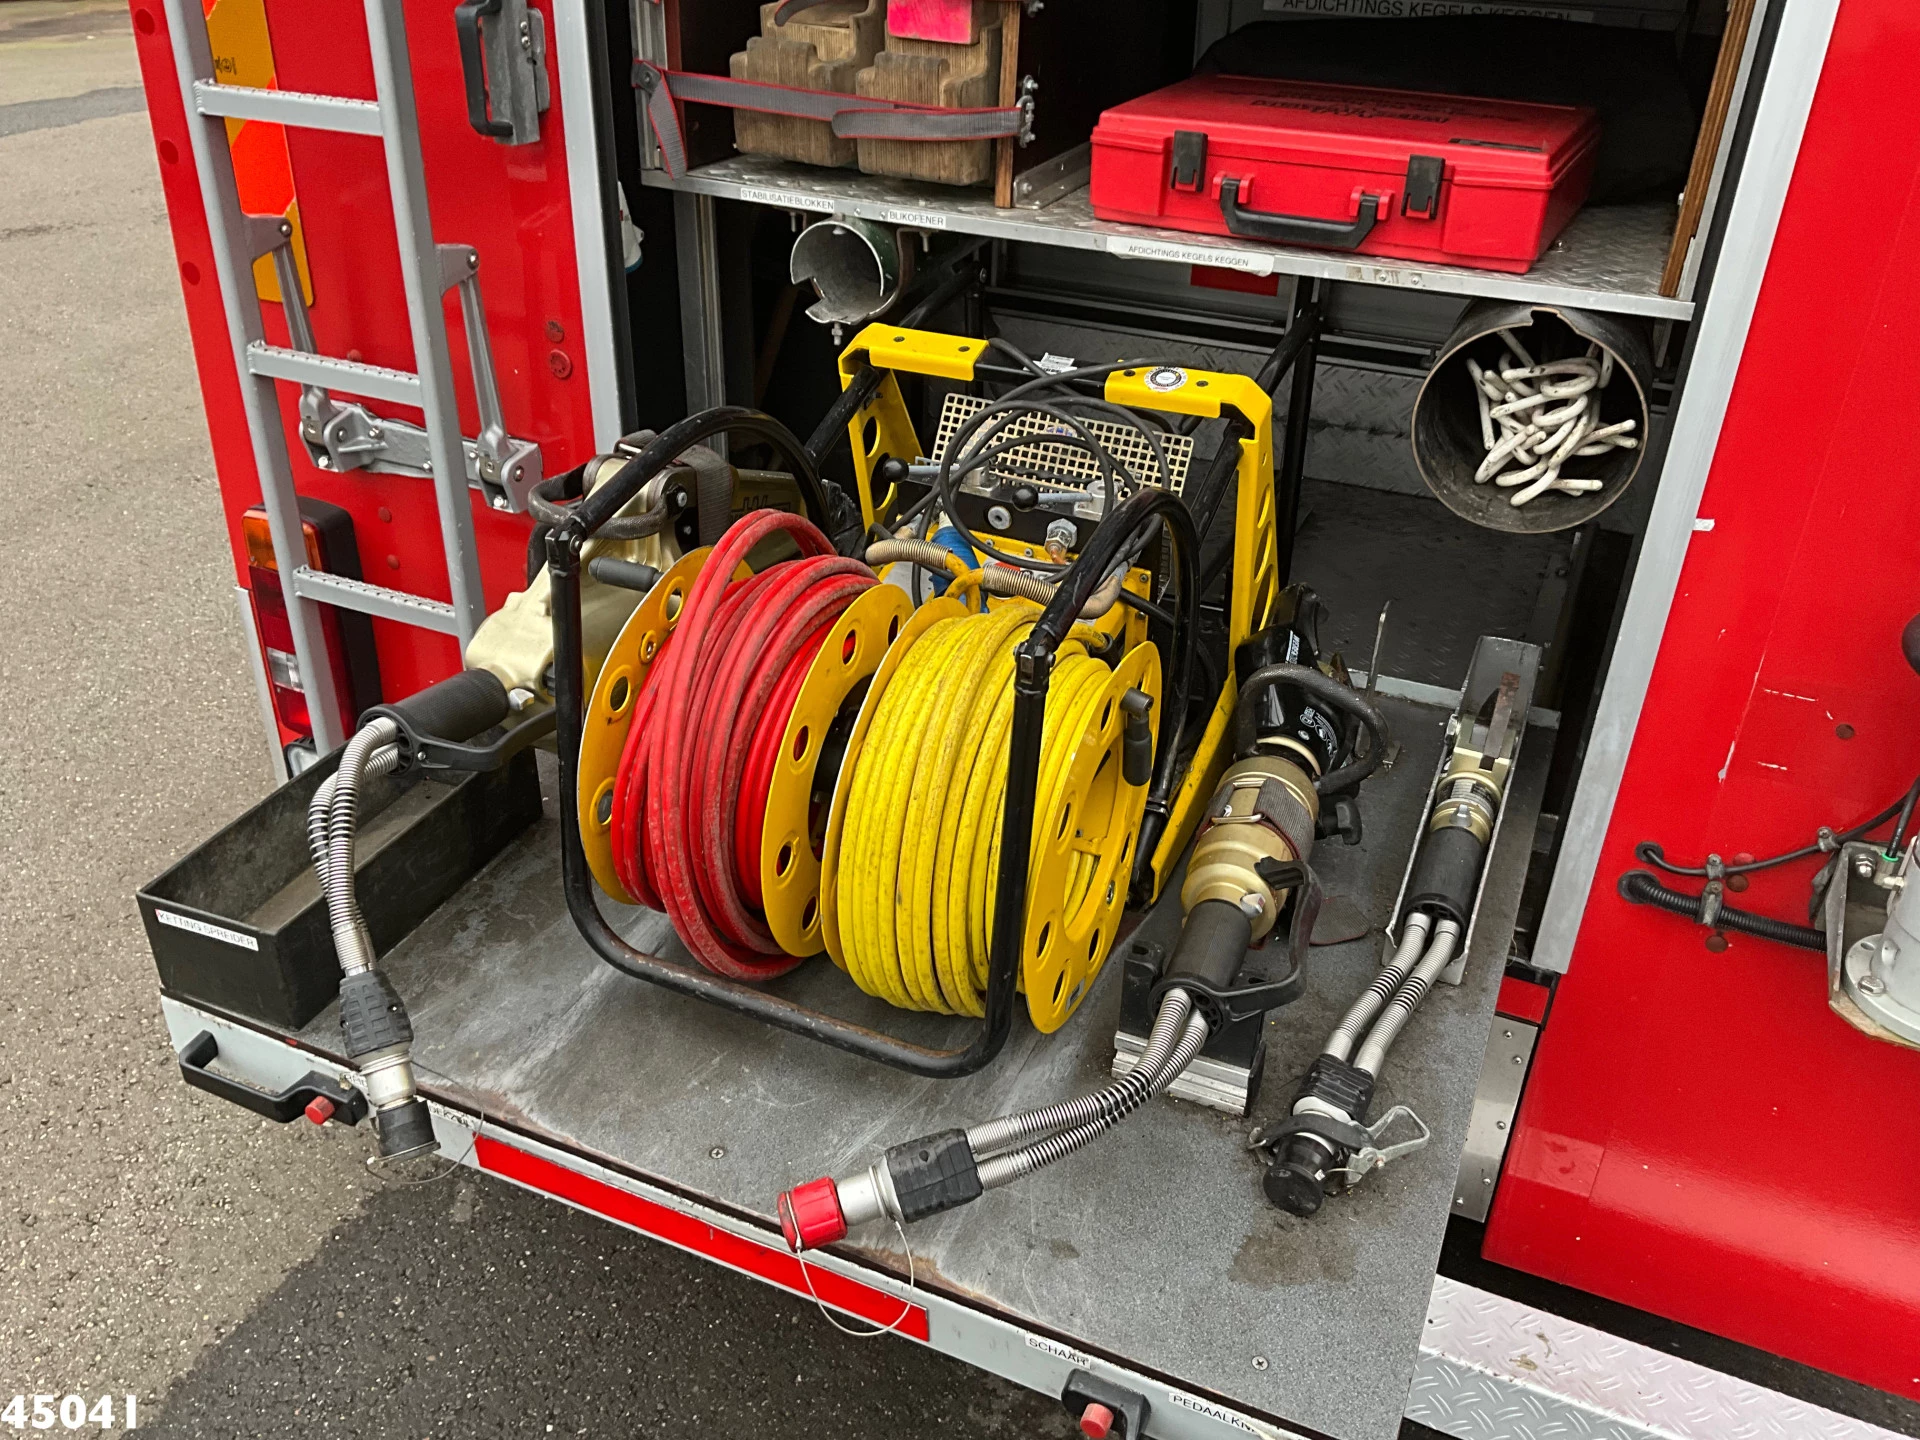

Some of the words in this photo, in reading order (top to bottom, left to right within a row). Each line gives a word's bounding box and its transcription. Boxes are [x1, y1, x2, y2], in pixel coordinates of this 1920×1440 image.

[741, 189, 834, 210] STABILISATIEBLOKKEN
[1128, 245, 1180, 259] AFDICHTINGS
[1181, 252, 1213, 263] KEGELS
[1214, 255, 1249, 267] KEGGEN
[159, 912, 202, 931] KETTING
[203, 925, 254, 947] SPREIDER
